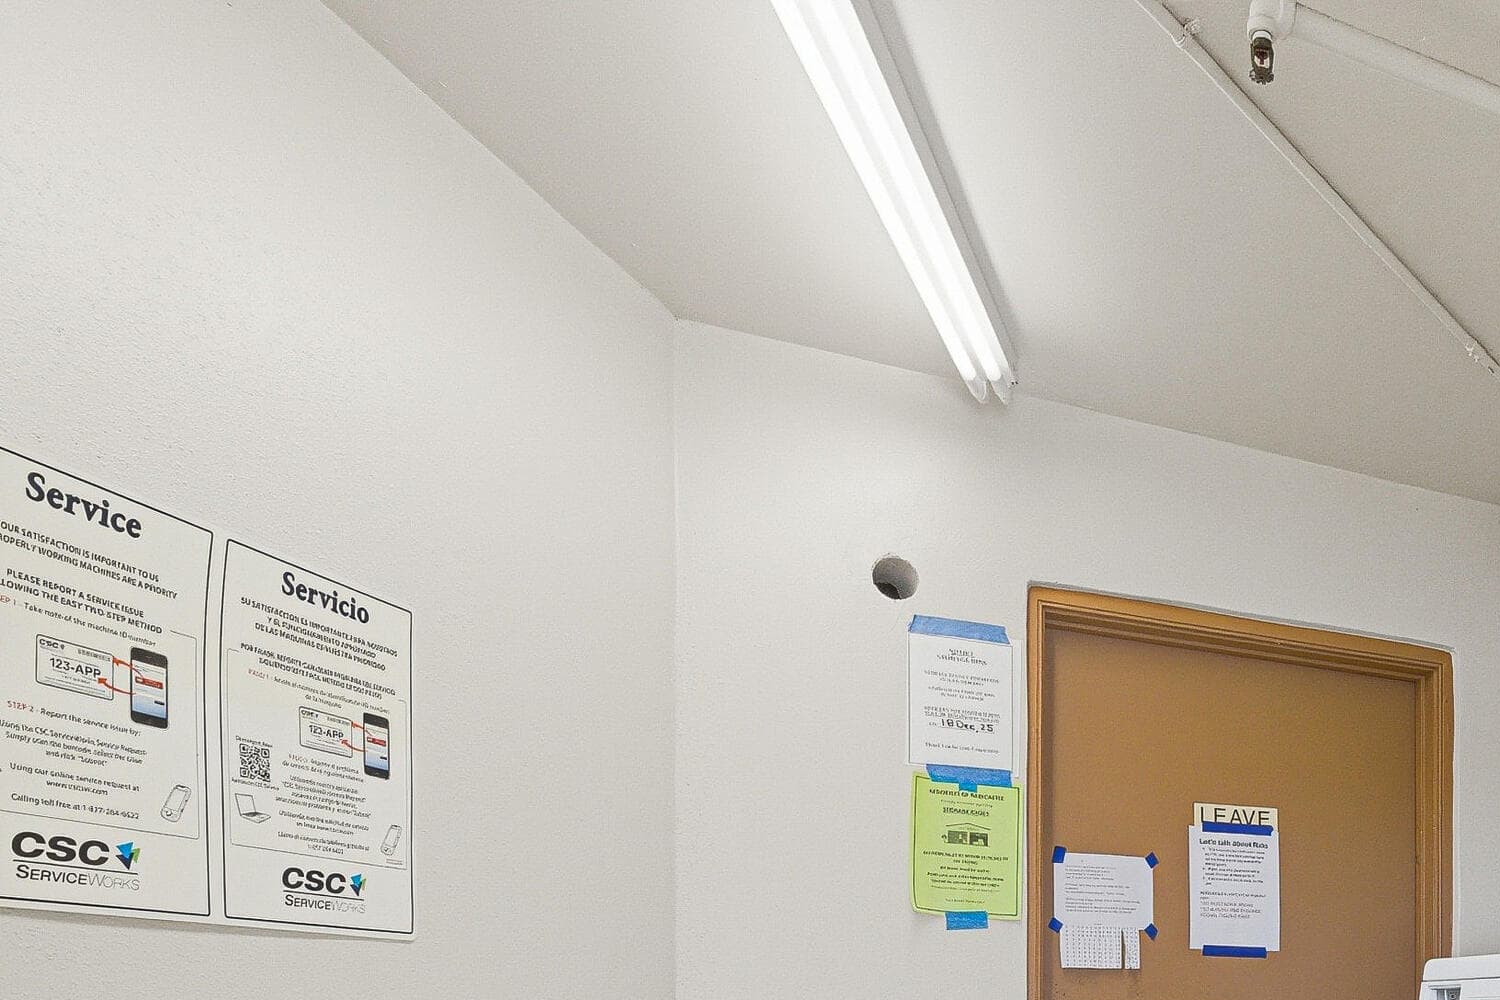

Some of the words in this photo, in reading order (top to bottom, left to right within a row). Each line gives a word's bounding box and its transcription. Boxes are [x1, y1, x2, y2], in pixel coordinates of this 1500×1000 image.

[25, 472, 142, 539] Service
[21, 527, 80, 556] SATISFACTION
[91, 551, 136, 575] IMPORTANT
[137, 567, 148, 579] TO
[38, 546, 78, 567] WORKING
[79, 559, 120, 581] MACHINES
[121, 574, 137, 587] ARE
[6, 568, 40, 586] PLEASE
[42, 579, 76, 597] REPORT
[78, 590, 84, 599] A
[86, 592, 120, 610] SERVICE
[121, 603, 144, 618] ISSUE
[23, 601, 41, 613] Take
[281, 571, 370, 624] Servicio
[42, 590, 58, 604] THE
[60, 596, 83, 611] EASY
[127, 617, 162, 635] METHOD
[49, 656, 100, 679] 123-APP
[40, 707, 67, 722] Report
[980, 723, 994, 733] 25
[308, 724, 343, 740] 123-APP
[11, 793, 39, 805] Calling
[1200, 806, 1270, 825] LEAVE
[11, 829, 109, 867] CSC
[15, 863, 139, 891] SERVICEWORKS
[282, 865, 345, 895] CSC
